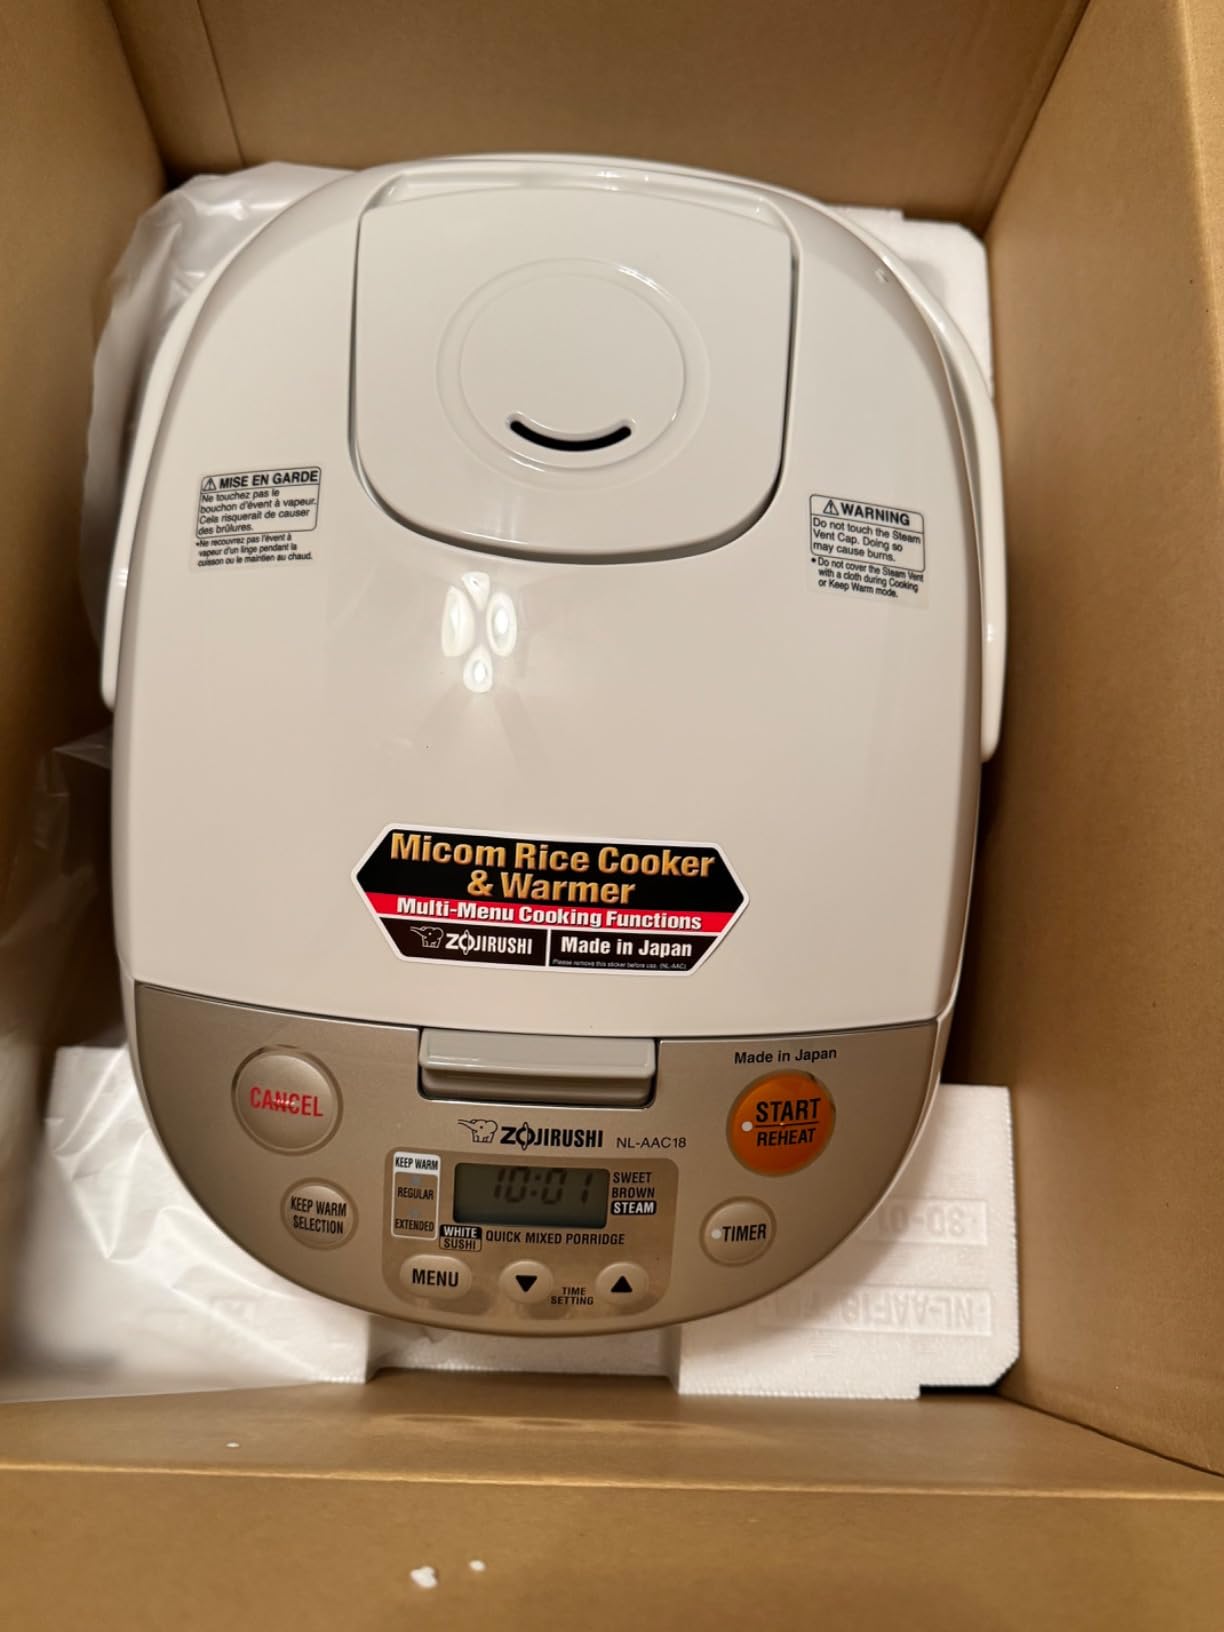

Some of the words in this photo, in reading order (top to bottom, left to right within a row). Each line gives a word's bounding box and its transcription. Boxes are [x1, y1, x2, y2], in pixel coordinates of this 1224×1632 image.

[220, 476, 249, 488] MISE
[252, 474, 269, 486] EN
[273, 471, 318, 484] GARDE
[216, 491, 250, 501] touchez
[253, 490, 269, 502] pas
[200, 503, 237, 513] bouchon
[200, 516, 219, 524] Cela
[221, 512, 262, 523] risquerait
[279, 509, 310, 517] causer
[841, 502, 910, 526] WARNING
[199, 527, 213, 535] des
[813, 517, 827, 527] Do
[830, 521, 844, 530] not
[847, 523, 873, 535] touch
[876, 528, 890, 538] the
[892, 531, 920, 544] Steam
[211, 538, 244, 546] recouvrez
[247, 536, 259, 546] pas
[813, 529, 835, 539] Vent
[837, 533, 860, 545] Cap.
[863, 536, 889, 551] Doing
[198, 549, 222, 558] vapeur
[241, 545, 257, 554] linge
[260, 543, 288, 553] pendant
[813, 542, 834, 553] may
[837, 545, 864, 556] cause
[868, 549, 895, 561] burns.
[198, 558, 223, 566] cuisson
[245, 554, 275, 562] maintien
[818, 557, 829, 566] Do
[831, 560, 843, 568] not
[846, 563, 867, 571] cover
[869, 565, 880, 574] the
[882, 567, 906, 578] Steam
[908, 571, 923, 582] Vent
[818, 569, 834, 577] with
[843, 573, 861, 581] cloth
[864, 575, 887, 587] during
[889, 578, 918, 593] Cooking
[829, 579, 849, 591] Keep
[851, 582, 874, 593] Warm
[876, 587, 898, 597] mode.
[390, 832, 506, 868] Micom
[515, 842, 590, 872] Rice
[598, 847, 715, 877] Cooker
[466, 870, 493, 897] &
[501, 872, 636, 904] Warmer
[396, 897, 514, 922] Multi-Menu
[519, 908, 601, 928] Cooking
[605, 913, 702, 930] Functions
[446, 929, 533, 955] ZOJIRUSHI
[561, 936, 611, 954] Made
[616, 937, 633, 954] in
[639, 940, 692, 958] Japan
[734, 1052, 772, 1064] Made
[778, 1051, 790, 1062] in
[795, 1049, 837, 1063] Japan
[251, 1087, 323, 1117] CANCEL
[756, 1098, 821, 1122] START
[500, 1122, 603, 1150] ZOJIRUSHI
[616, 1137, 686, 1148] NL-AAC18
[757, 1128, 816, 1146] REHEAT
[395, 1156, 413, 1168] KEEP
[415, 1159, 438, 1170] WARM
[494, 1167, 593, 1204] 10:01
[613, 1172, 652, 1183] SWEET
[398, 1187, 433, 1200] REGULAR
[612, 1187, 655, 1198] BROWN
[291, 1196, 313, 1212] KEEP
[316, 1200, 347, 1217] WARM
[614, 1202, 654, 1213] STEAM
[293, 1215, 343, 1234] SELECTION
[395, 1218, 434, 1232] EXTENDED
[444, 1226, 477, 1238] WHITE
[722, 1224, 766, 1242] TIMER
[444, 1239, 476, 1249] SUSHI
[486, 1231, 521, 1242] QUICK
[525, 1232, 561, 1244] MIXED
[566, 1234, 624, 1245] PORRIDGE
[412, 1269, 458, 1287] MENU
[562, 1287, 586, 1296] TIME
[551, 1296, 593, 1305] SETTING
